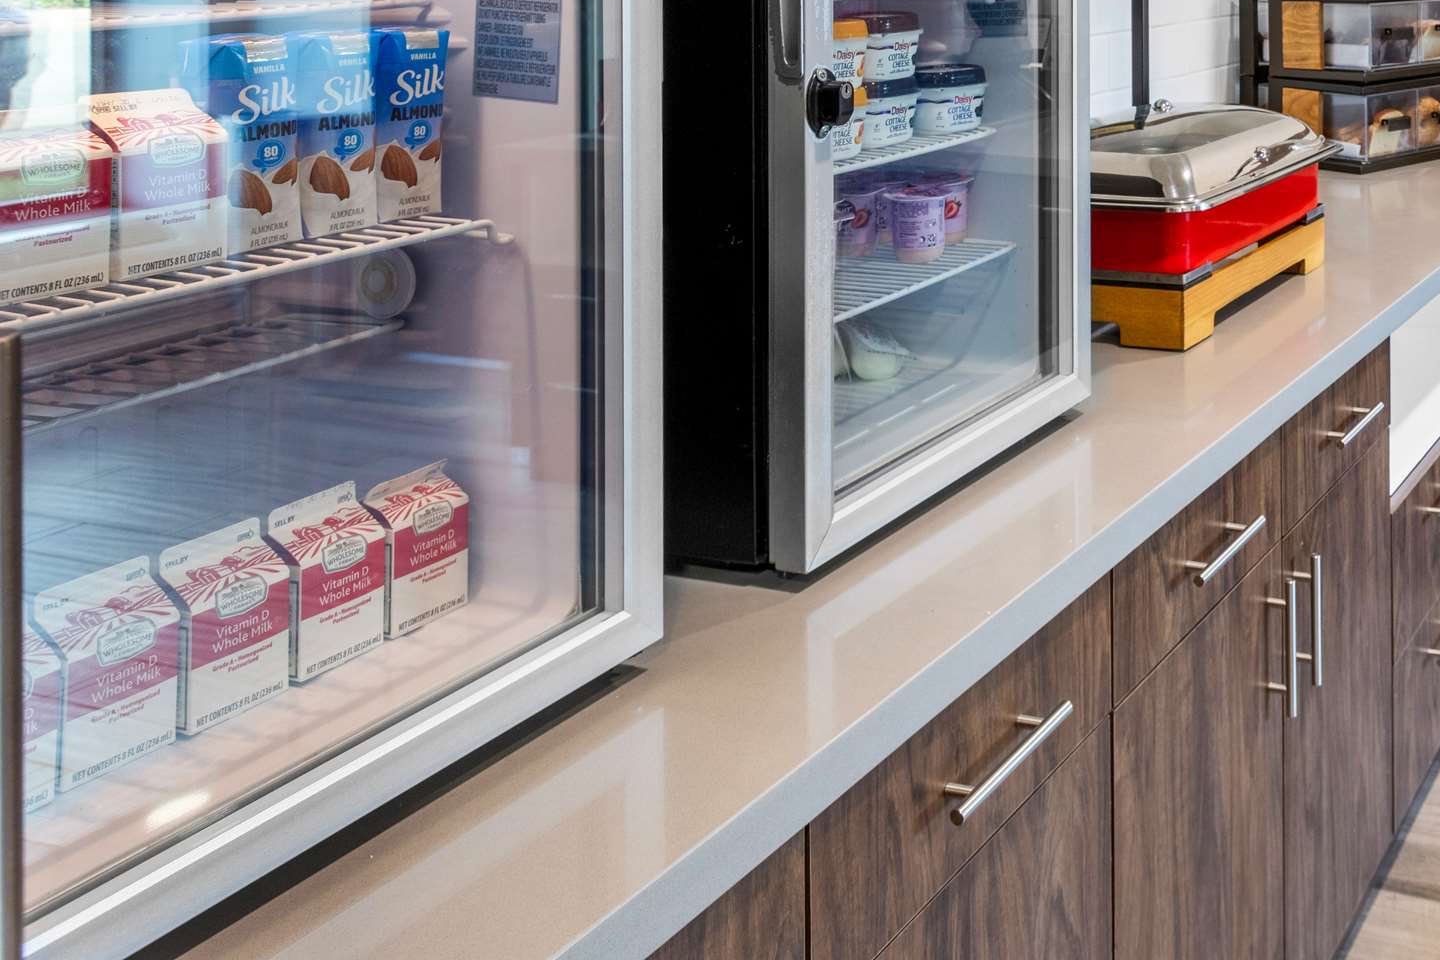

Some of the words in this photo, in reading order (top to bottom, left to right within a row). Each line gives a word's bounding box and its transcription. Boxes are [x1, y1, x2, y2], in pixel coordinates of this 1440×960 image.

[411, 52, 437, 60] VANILLA
[837, 49, 856, 61] Daisy
[894, 40, 911, 54] Daisy
[253, 64, 286, 74] VANILLA
[339, 57, 367, 66] VANILLA
[834, 61, 854, 70] OTTAGE
[317, 69, 376, 113] Silk
[390, 64, 444, 105] Silk
[231, 76, 297, 125] Silk
[891, 106, 907, 116] Daisy
[955, 96, 972, 104] Daisy
[344, 135, 357, 146] 80
[414, 126, 426, 136] 80
[264, 146, 278, 158] 80
[28, 163, 81, 177] WHOLESOME
[149, 169, 195, 187] Vitamin
[145, 186, 184, 201] Whole
[187, 180, 211, 194] Milk
[15, 204, 60, 221] Whole
[64, 199, 91, 214] Milk
[128, 264, 141, 275] NET
[142, 258, 174, 273] CONTENTS
[180, 255, 187, 264] FL
[188, 254, 196, 262] OZ
[211, 247, 223, 258] mL)
[0, 288, 10, 300] ET
[11, 282, 48, 298] CONTENTS
[49, 283, 54, 291] 8
[55, 280, 62, 290] FL
[64, 277, 73, 287] OZ
[74, 275, 90, 287] (236
[91, 272, 104, 283] mL)
[412, 533, 446, 553] Vitamin
[448, 529, 455, 539] D
[409, 549, 438, 567] Whole
[440, 539, 457, 553] Milk
[322, 570, 360, 592] Vitamin
[362, 566, 369, 576] D
[319, 587, 351, 606] Whole
[352, 576, 372, 593] Milk
[216, 615, 259, 638] Vitamin
[261, 609, 270, 620] D
[212, 633, 249, 653] Whole
[251, 620, 273, 637] Milk
[96, 661, 145, 687] Vitamin
[149, 654, 158, 667] D
[306, 663, 316, 673] NET
[317, 652, 342, 669] CONTENTS
[91, 681, 133, 704] Whole
[137, 666, 161, 687] Milk
[196, 716, 208, 728] NET
[209, 703, 238, 722] CONTENTS
[244, 696, 250, 705] FL
[251, 691, 259, 702] OZ
[72, 770, 87, 783] NET
[87, 755, 121, 776] CONTENTS
[127, 747, 135, 758] FL
[136, 741, 145, 753] OZ
